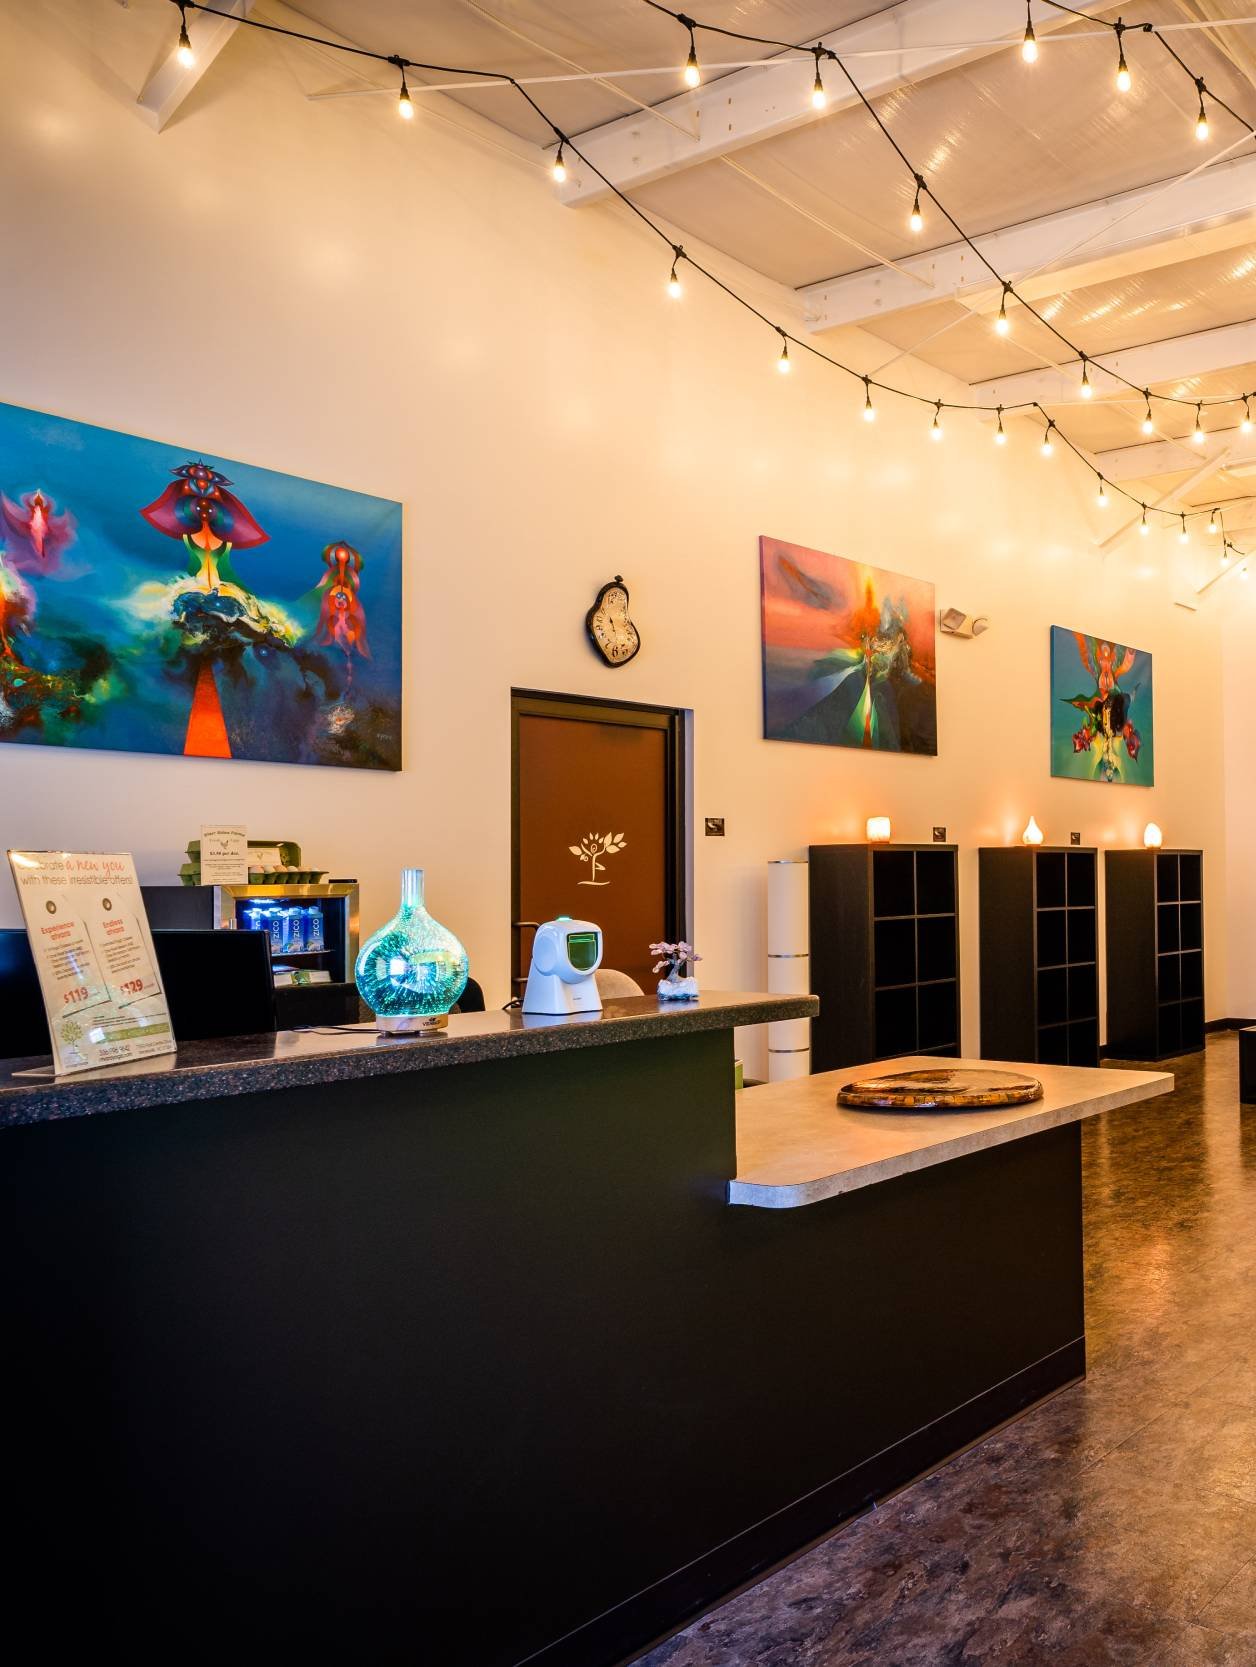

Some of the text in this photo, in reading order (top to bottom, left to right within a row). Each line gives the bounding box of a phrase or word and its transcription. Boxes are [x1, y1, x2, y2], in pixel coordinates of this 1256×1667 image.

[102, 860, 125, 877] you
[21, 875, 41, 886] with
[41, 875, 68, 886] these
[272, 920, 280, 939] ZICO
[292, 919, 300, 938] ZICO
[63, 986, 89, 1004] $119
